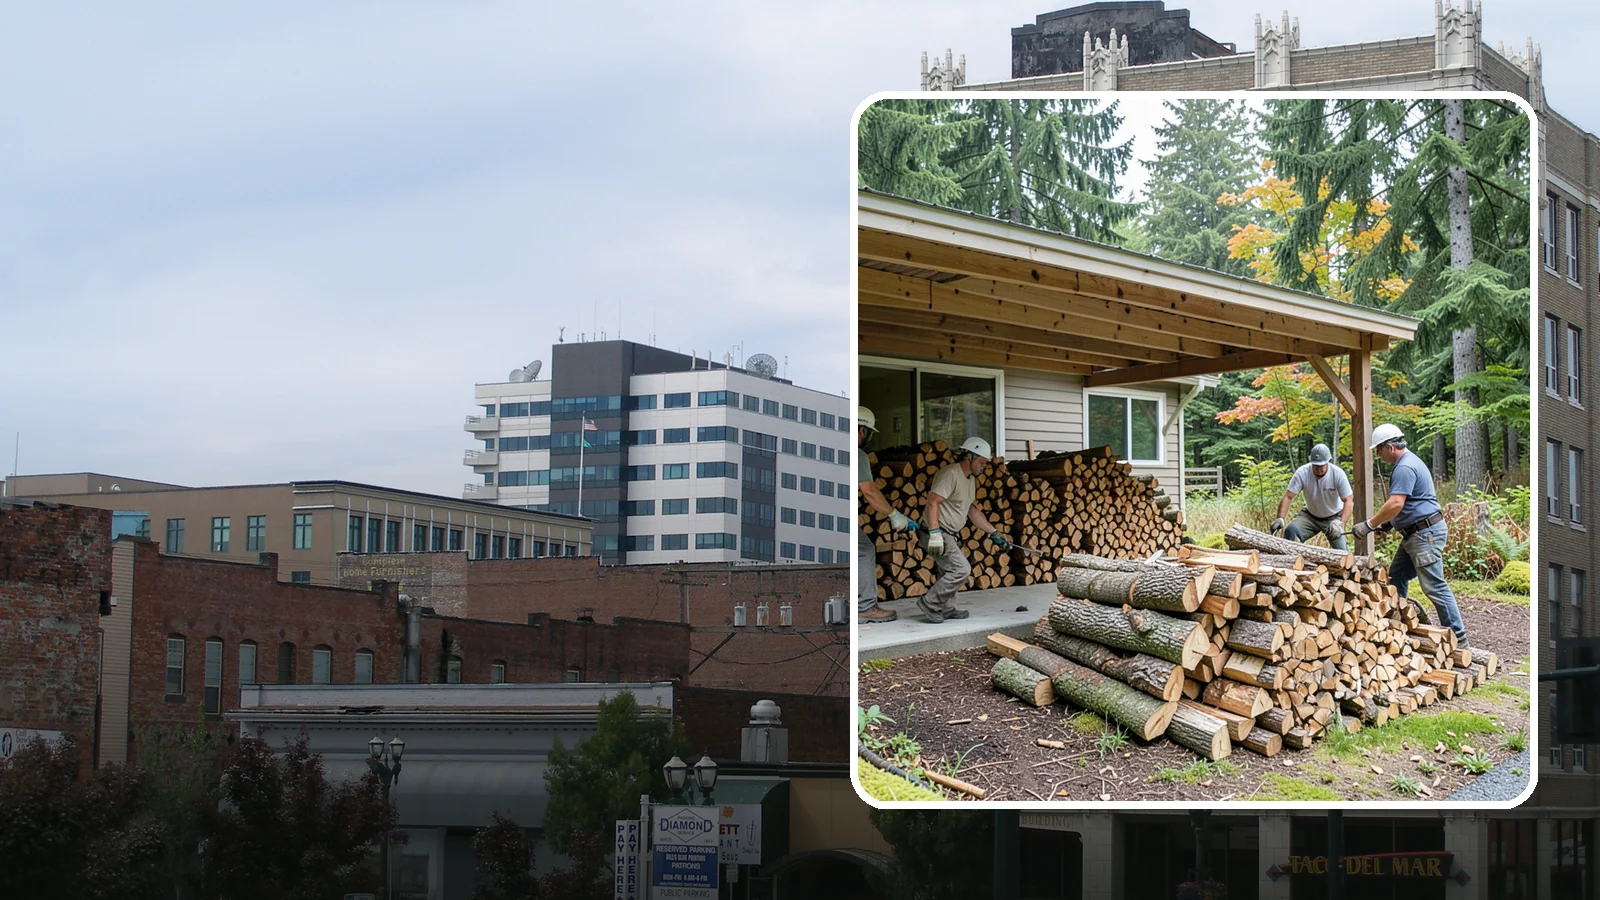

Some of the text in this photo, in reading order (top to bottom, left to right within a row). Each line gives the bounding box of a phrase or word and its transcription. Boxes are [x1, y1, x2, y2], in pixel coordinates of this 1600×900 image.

[343, 566, 427, 577] Home Furnishers
[660, 818, 713, 833] DIAMOND
[1022, 815, 1070, 828] BUILDING
[719, 823, 740, 835] ETT
[655, 845, 716, 854] RESERVED PARKING
[719, 839, 740, 849] ANT
[616, 824, 625, 894] PAY HERE
[627, 824, 637, 894] PAY HERE
[722, 851, 739, 862] Soup
[671, 862, 701, 870] PATRONS
[1289, 855, 1443, 877] TAC DEL MAR
[660, 888, 710, 898] PUBLIC PARKING
